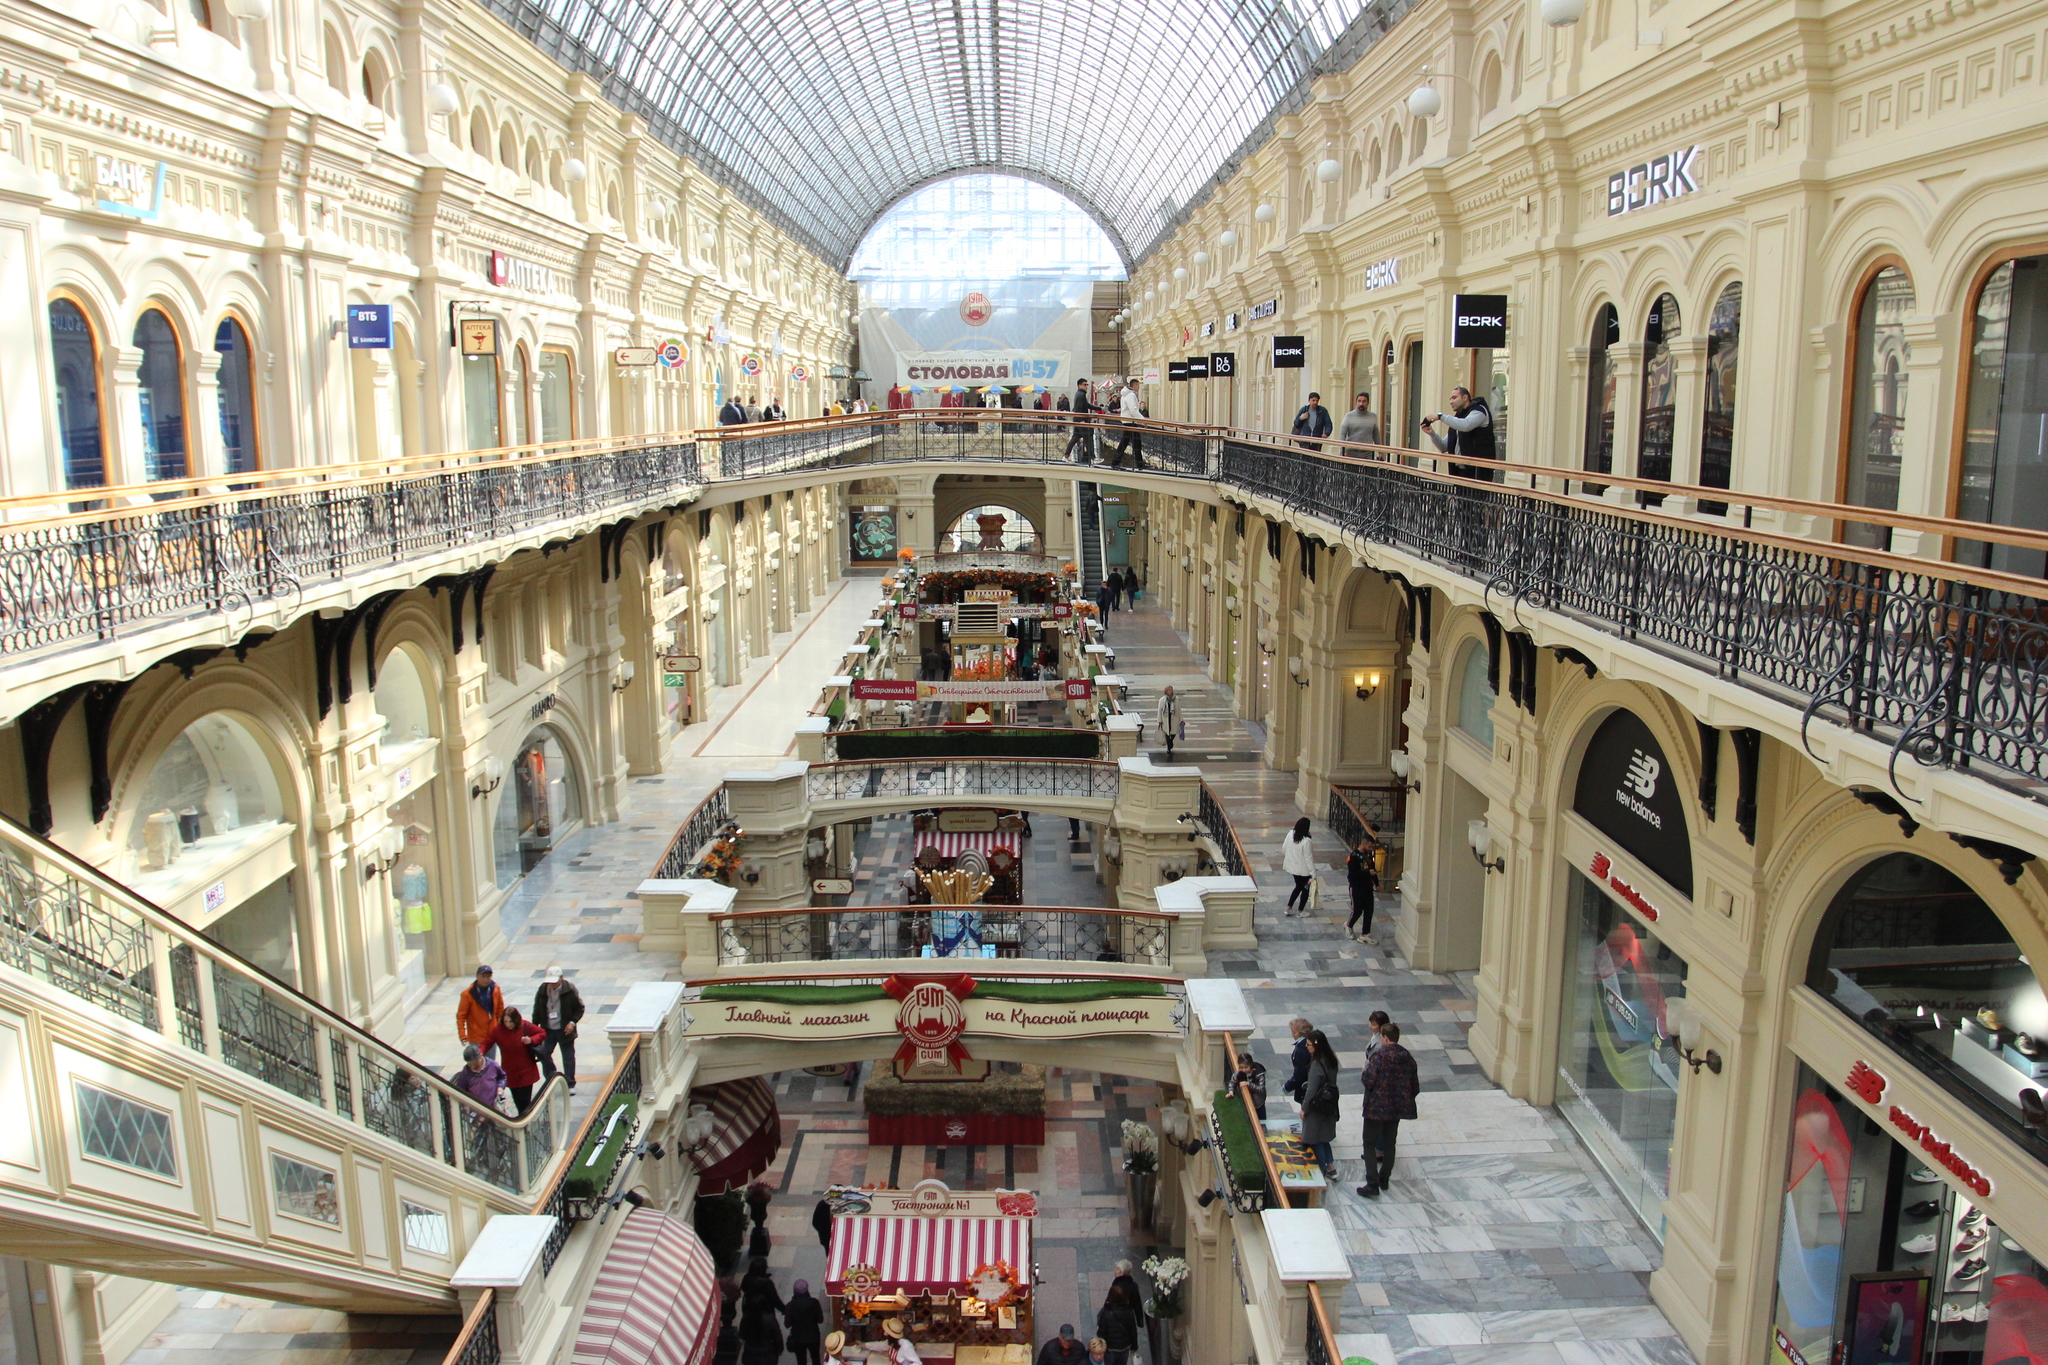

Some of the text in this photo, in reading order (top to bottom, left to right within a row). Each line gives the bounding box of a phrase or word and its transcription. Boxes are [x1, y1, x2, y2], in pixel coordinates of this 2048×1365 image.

[96, 155, 148, 193] БАНК
[1608, 145, 1698, 217] BORK
[507, 257, 555, 293] АПТЕКА
[1366, 257, 1397, 291] BORK
[358, 311, 378, 322] ВТБ
[1458, 316, 1503, 327] BORK
[907, 365, 1009, 379] СТОЛОВАЯ
[860, 685, 904, 695] Гастроном
[938, 686, 982, 696] Отведайте
[1068, 684, 1084, 696] ГУМ
[1616, 789, 1661, 829] new balance
[916, 987, 945, 1007] ГУМ
[725, 1006, 870, 1026] Главный магазин
[985, 1008, 1149, 1028] на Красной площади
[904, 1031, 958, 1048] КРАСНАЯ ПЛОЩАДЬ
[921, 1050, 942, 1060] GUM
[1889, 1105, 1923, 1141] new
[1920, 1126, 1991, 1197] balance
[892, 1199, 955, 1211] Гастроном
